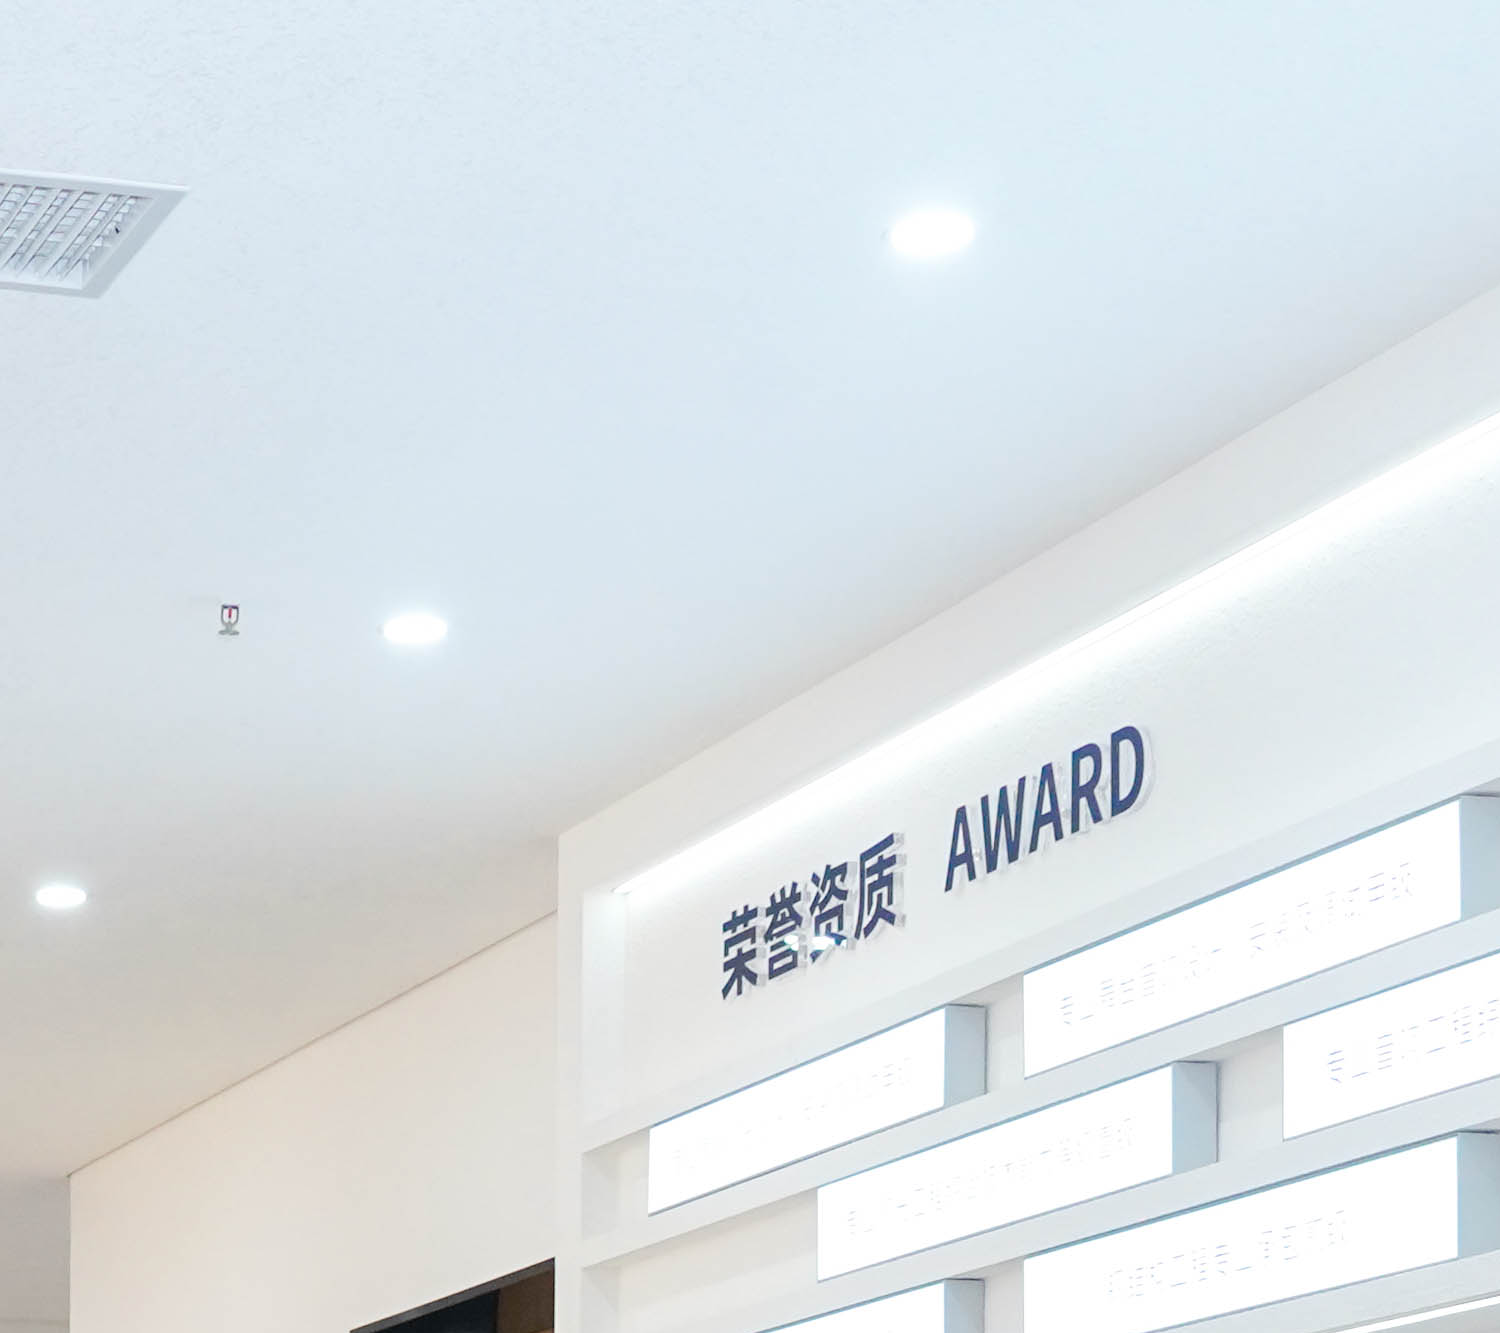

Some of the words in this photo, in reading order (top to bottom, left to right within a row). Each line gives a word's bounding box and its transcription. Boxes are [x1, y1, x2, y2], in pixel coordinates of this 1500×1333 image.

[720, 832, 904, 1001] 荣誉资质
[943, 724, 1148, 894] AWARD
